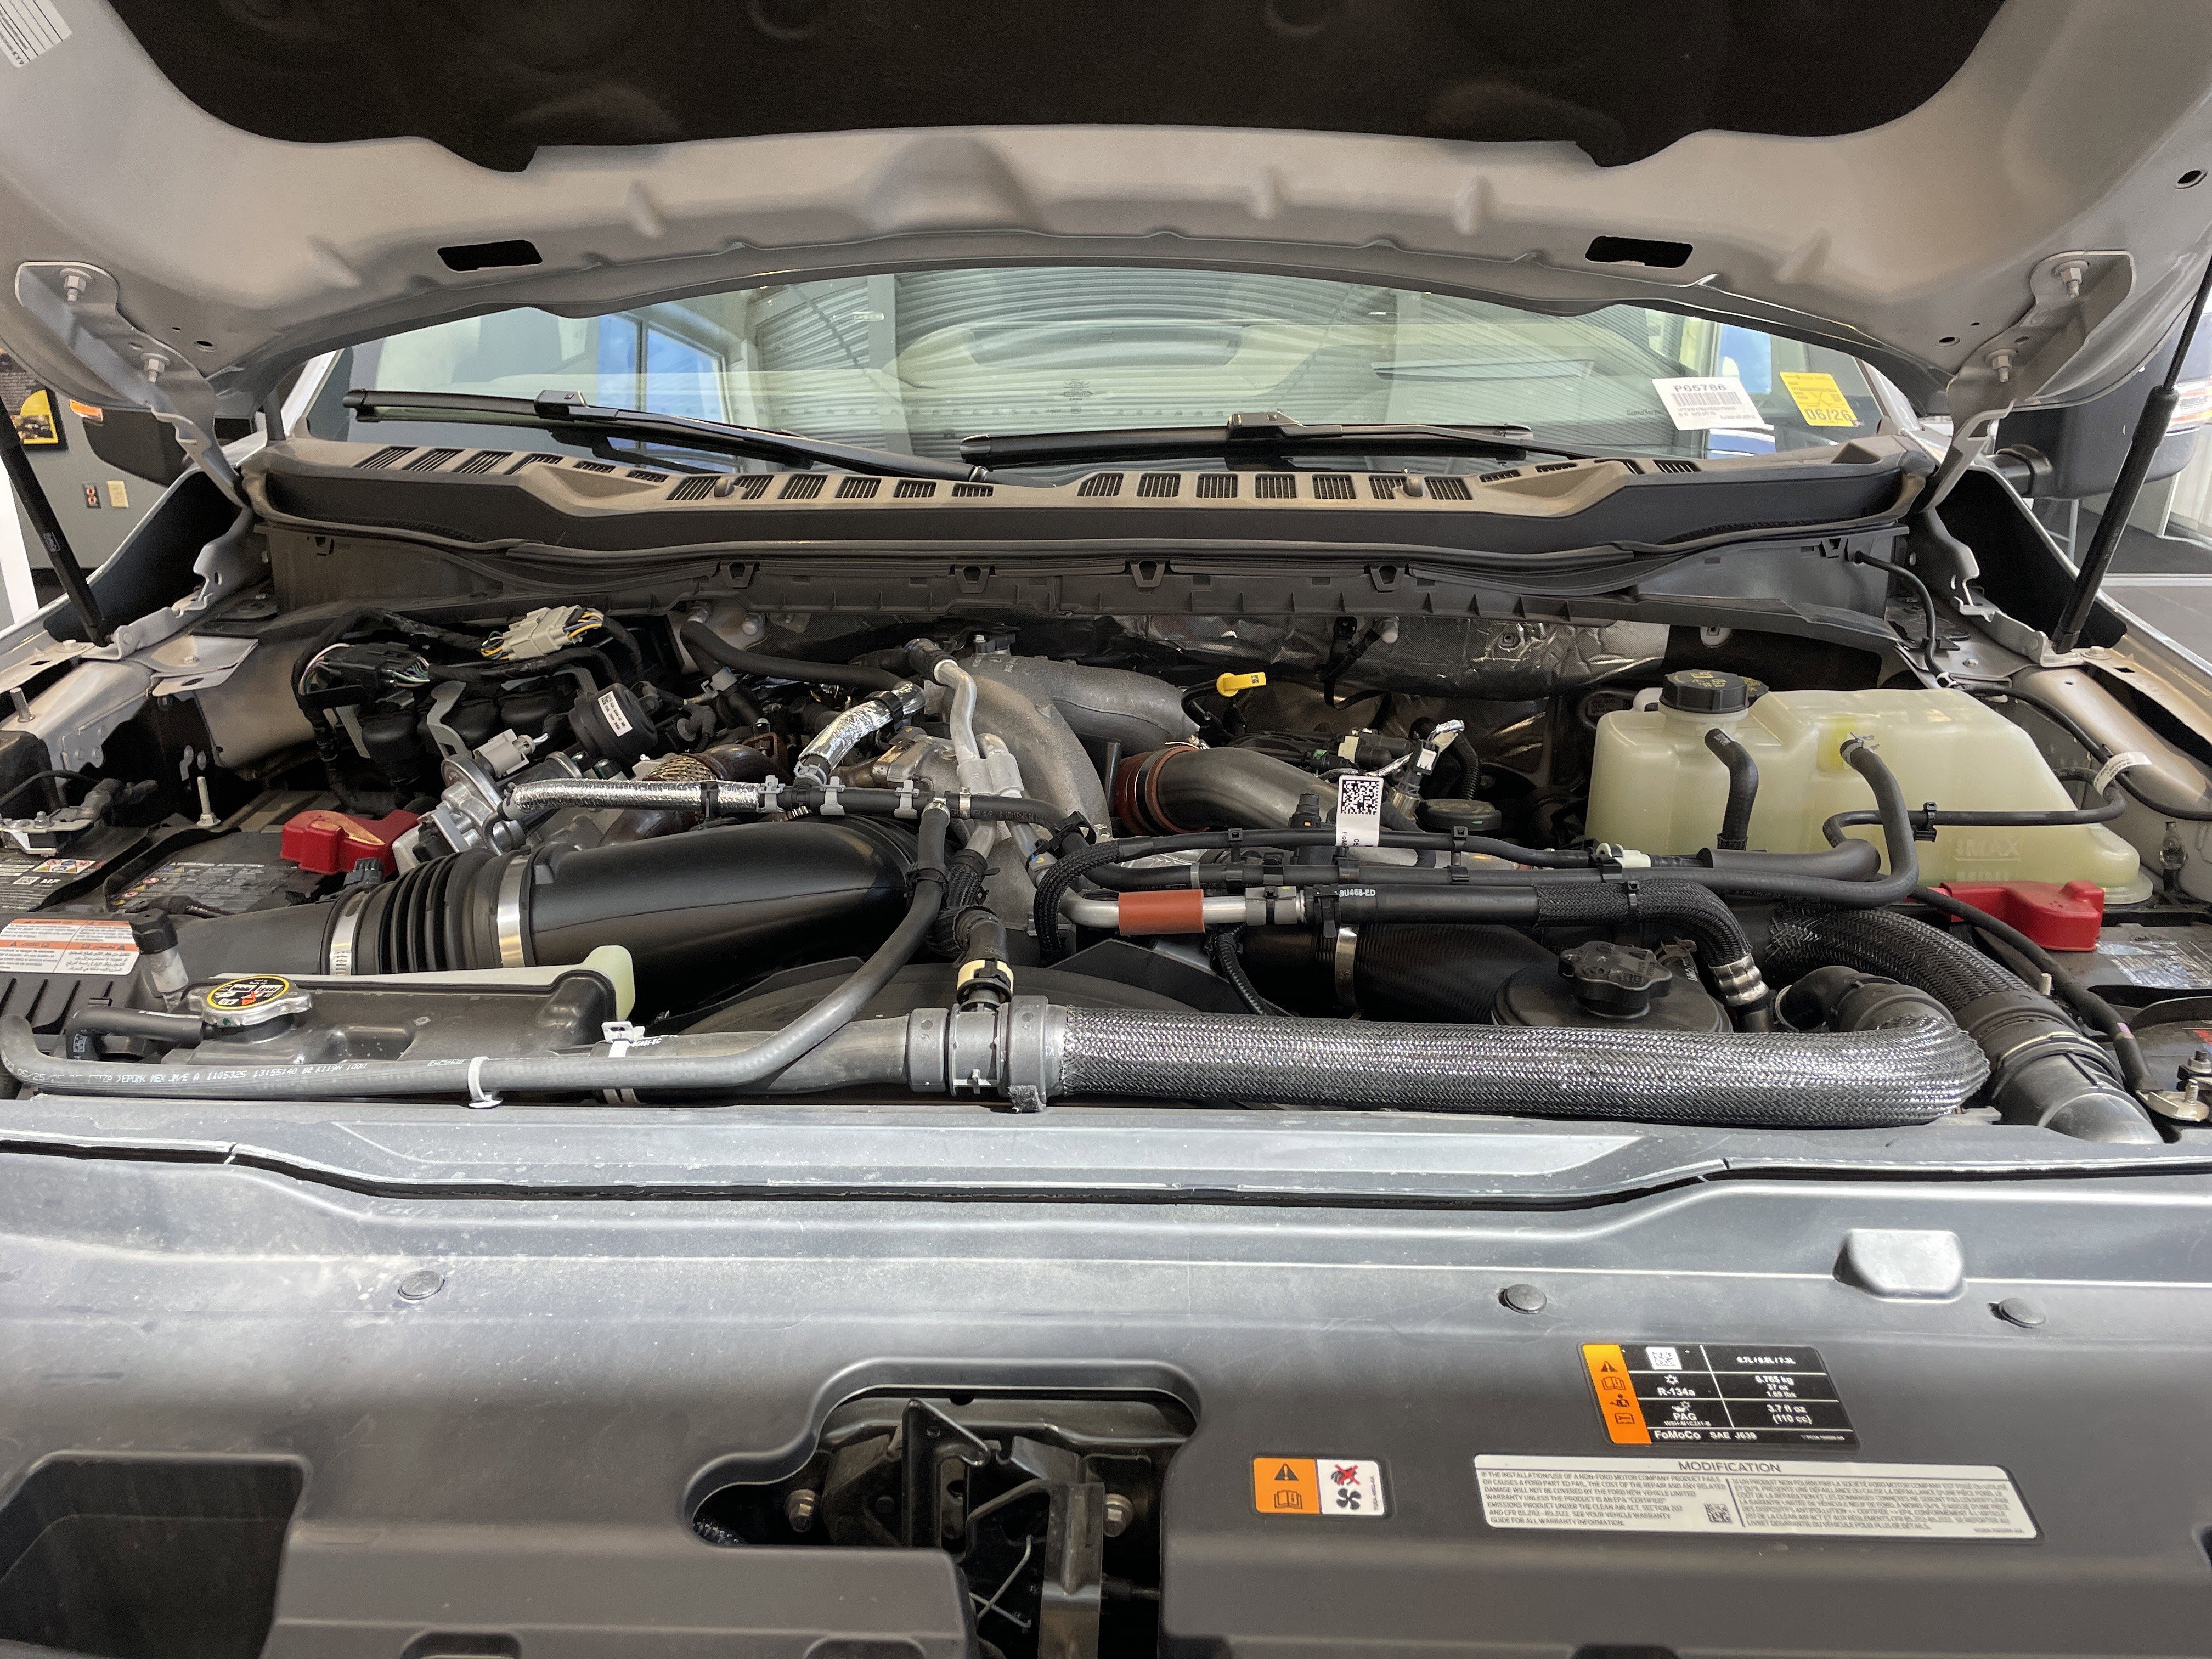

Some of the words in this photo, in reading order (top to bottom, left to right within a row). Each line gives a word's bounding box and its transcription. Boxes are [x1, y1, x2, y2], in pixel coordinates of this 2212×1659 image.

[1804, 408, 1852, 421] 06/26
[1754, 1375, 1780, 1384] 0.765
[1780, 1375, 1795, 1386] kg
[1657, 1387, 1696, 1396] R-134a
[1767, 1404, 1782, 1413] 3.7
[1672, 1412, 1698, 1421] PAG
[1772, 1414, 1795, 1425] (110
[1795, 1414, 1813, 1425] cc)
[1654, 1430, 1702, 1440] FoMoCo
[1709, 1431, 1732, 1440] SAE
[1735, 1431, 1758, 1440] J639
[1678, 1461, 1781, 1472] MODIFICATION
